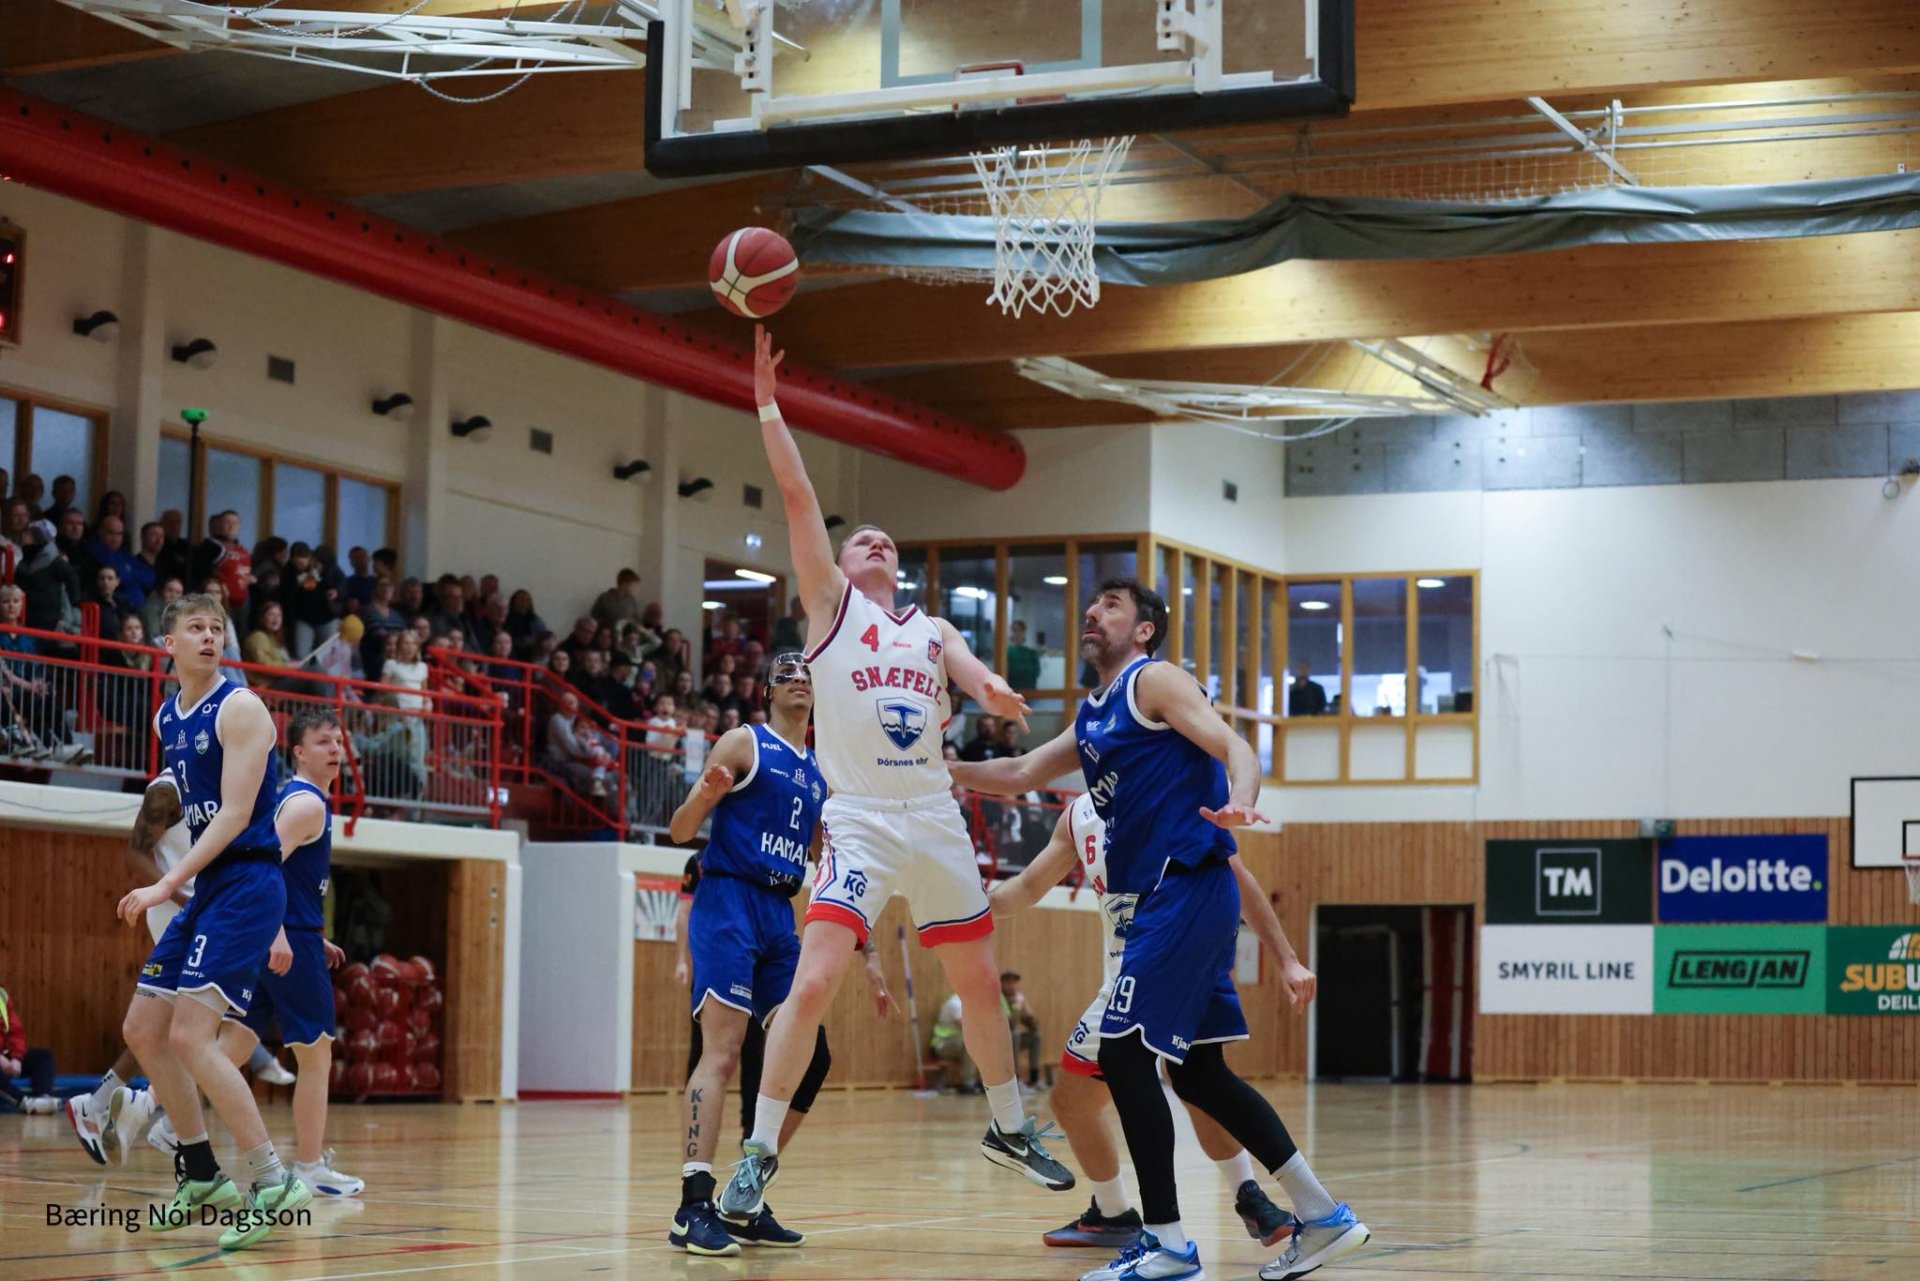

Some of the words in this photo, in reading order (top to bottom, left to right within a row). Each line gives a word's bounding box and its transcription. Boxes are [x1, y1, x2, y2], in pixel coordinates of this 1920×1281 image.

[861, 624, 879, 652] 4
[177, 760, 190, 793] 3
[790, 796, 803, 830] 2
[1085, 835, 1096, 866] 6
[843, 875, 867, 898] KG
[1543, 867, 1593, 897] TM
[188, 934, 207, 968] 3
[1498, 961, 1579, 980] SMYRIL
[1586, 961, 1635, 980] LINE
[1108, 975, 1136, 1013] 19
[1878, 994, 1920, 1011] DEIL
[686, 1088, 704, 1158] KING
